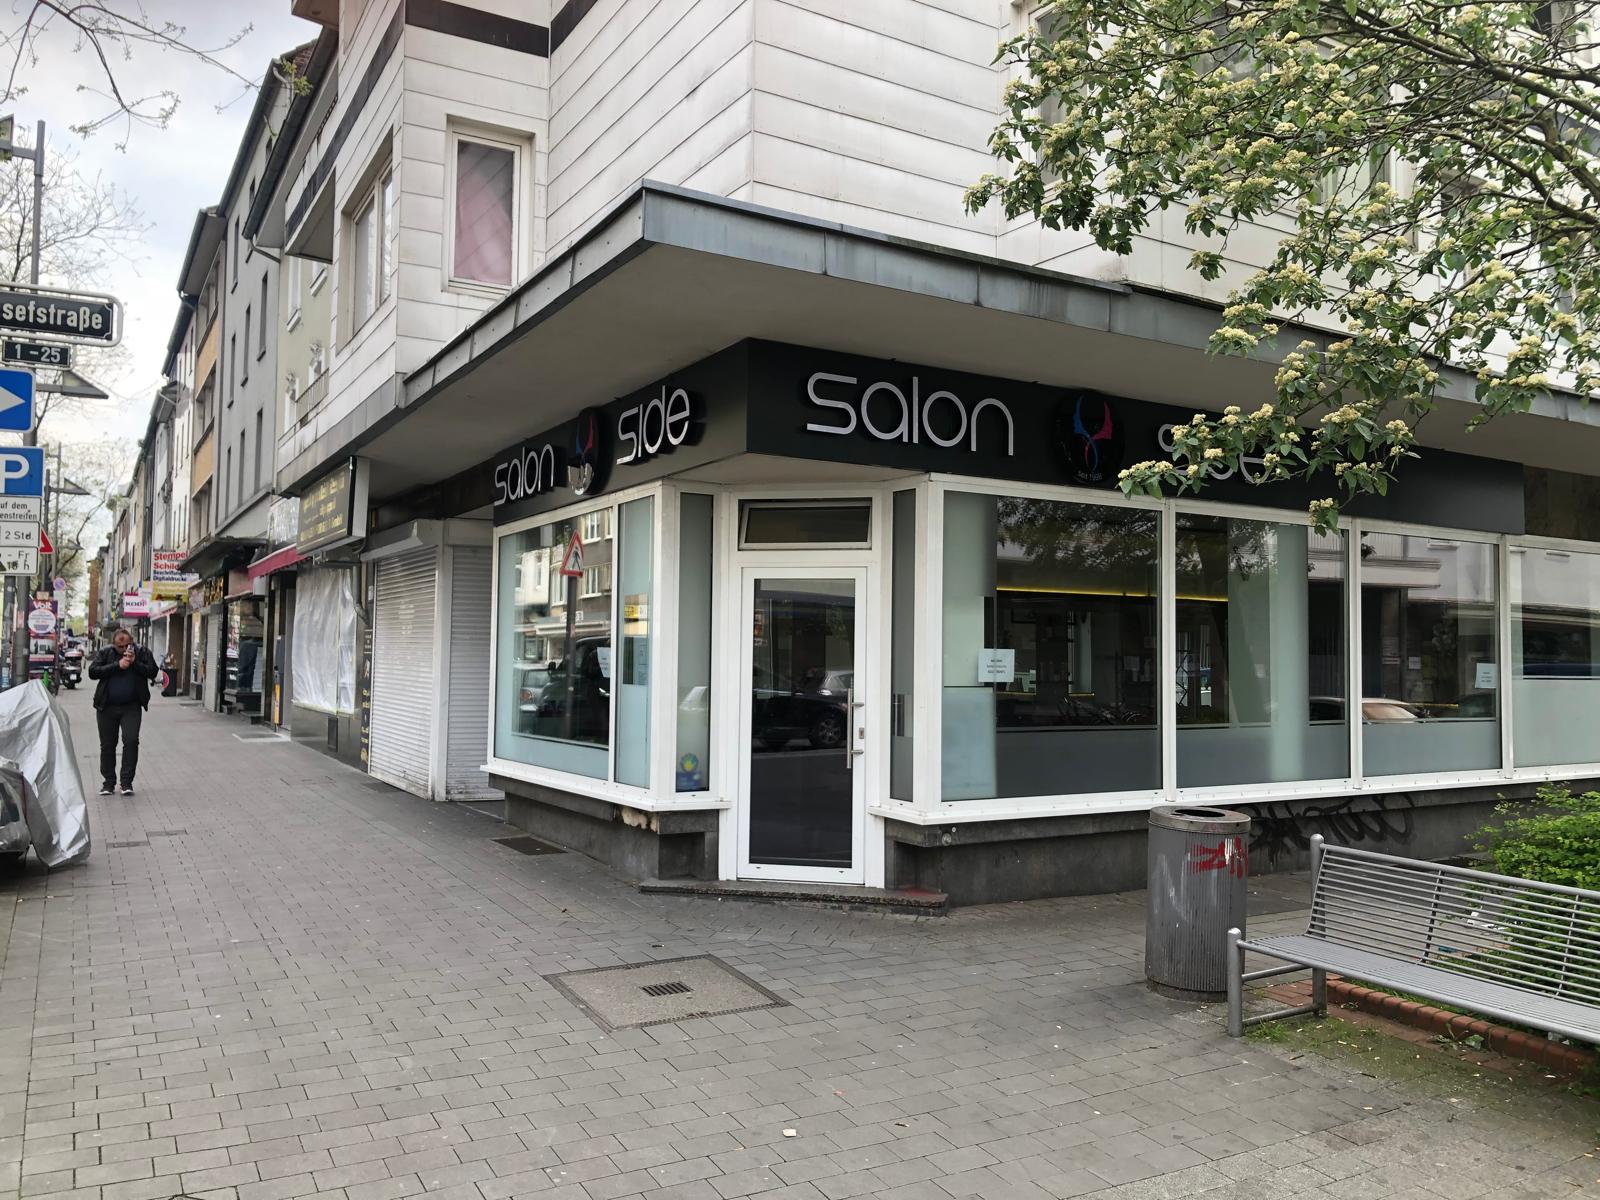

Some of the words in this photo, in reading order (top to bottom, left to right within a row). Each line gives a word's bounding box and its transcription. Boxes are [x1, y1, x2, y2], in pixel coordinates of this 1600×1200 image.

[616, 385, 690, 465] side
[806, 372, 1014, 456] salon
[0, 453, 30, 493] P
[494, 443, 555, 506] salon
[11, 502, 28, 510] dem
[5, 530, 11, 540] 2
[18, 550, 30, 560] Fr
[33, 600, 53, 609] Volt
